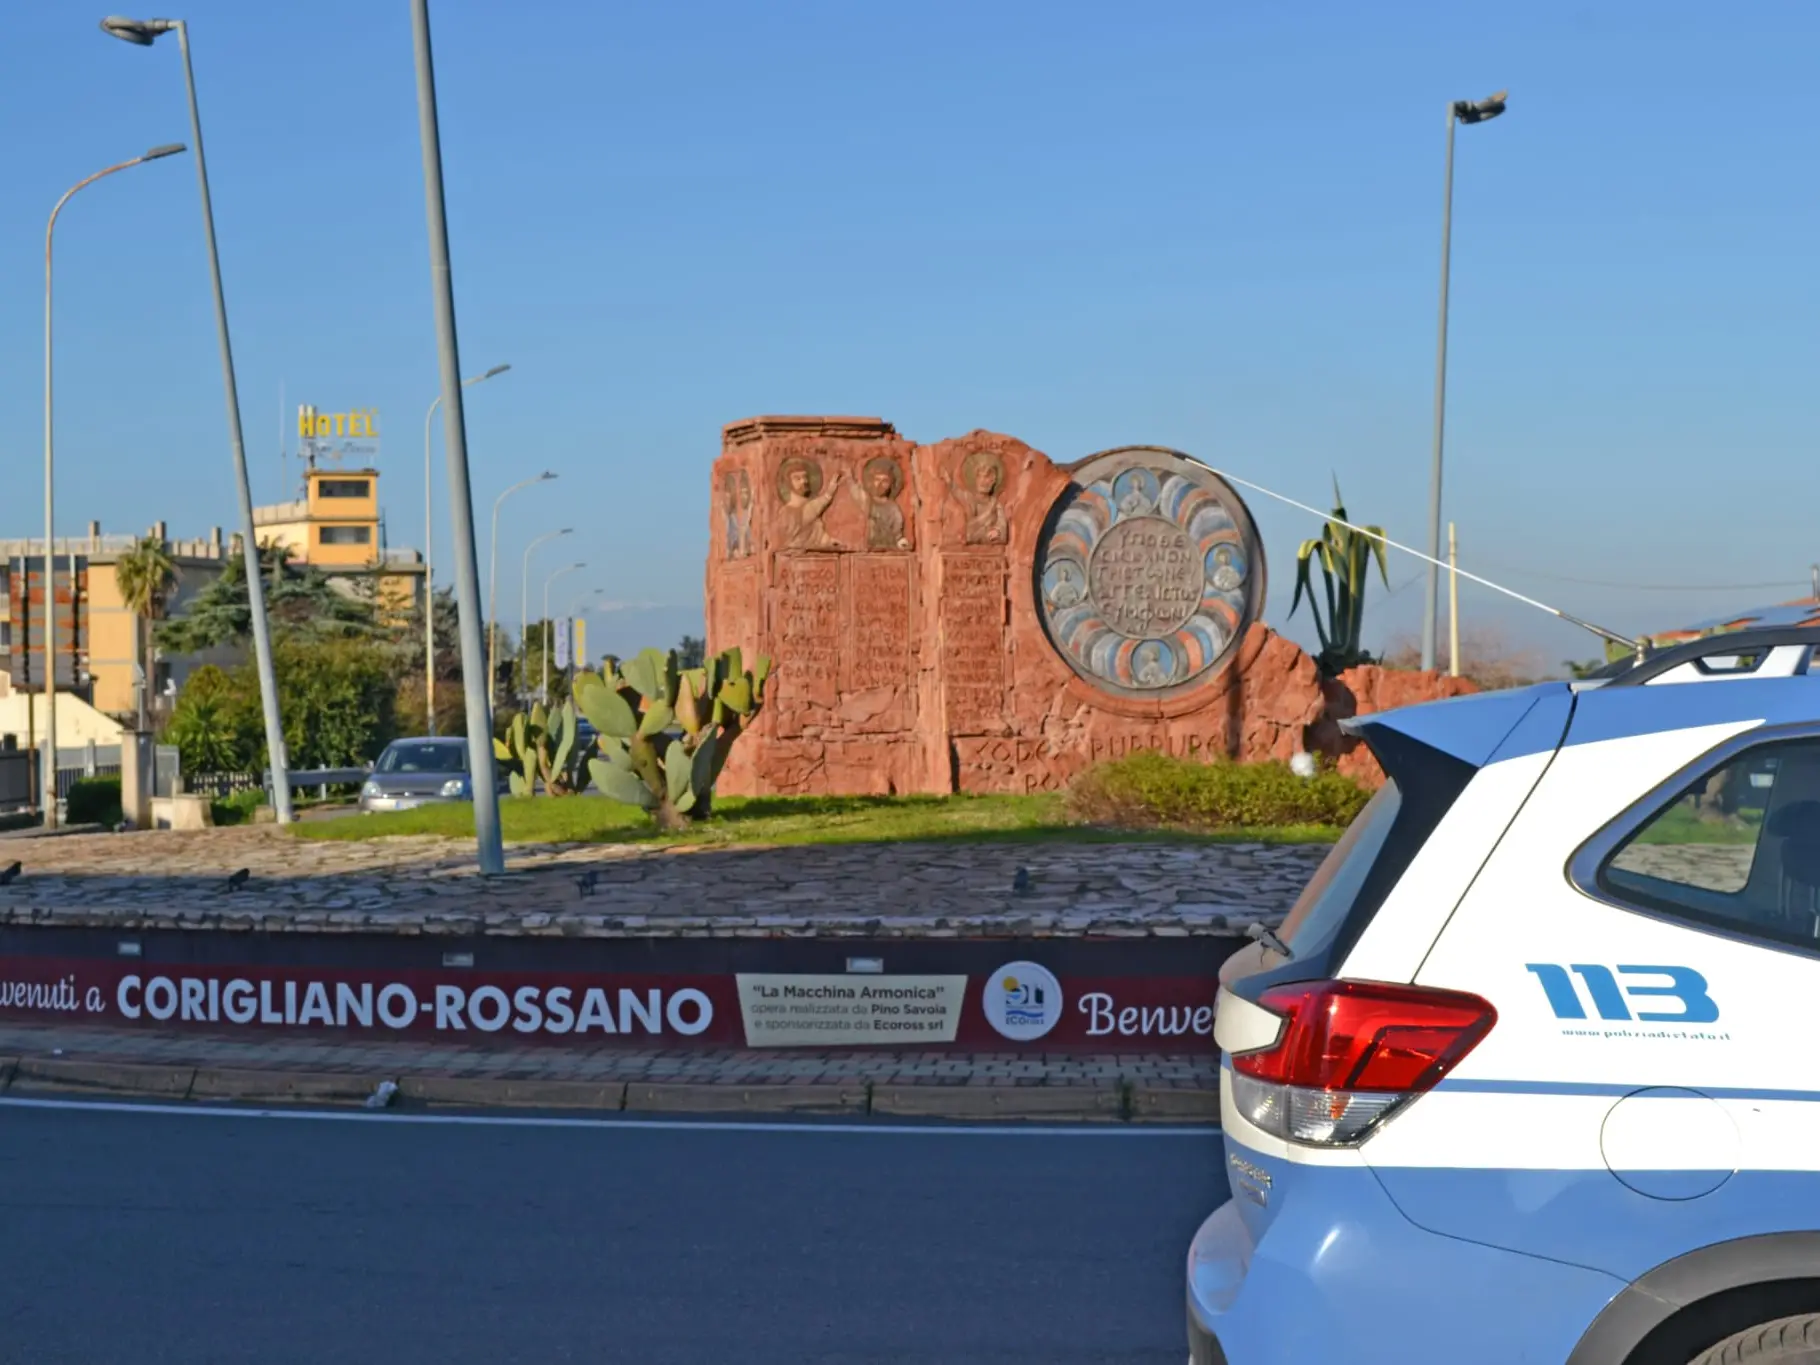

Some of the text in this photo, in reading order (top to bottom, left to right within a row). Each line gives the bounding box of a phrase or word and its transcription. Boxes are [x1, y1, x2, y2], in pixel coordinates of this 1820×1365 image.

[298, 413, 378, 437] HOTEL
[784, 985, 855, 999] Macchina
[1525, 963, 1719, 1023] 113
[0, 974, 713, 1035] venuti a CORIGLIANO-ROSSANO
[853, 1002, 868, 1015] da
[871, 1002, 900, 1015] Pino
[904, 1002, 947, 1015] Savoia
[1078, 992, 1213, 1035] Benve
[854, 1017, 871, 1031] da
[874, 1019, 925, 1031] Ecoross
[928, 1018, 943, 1030] srl
